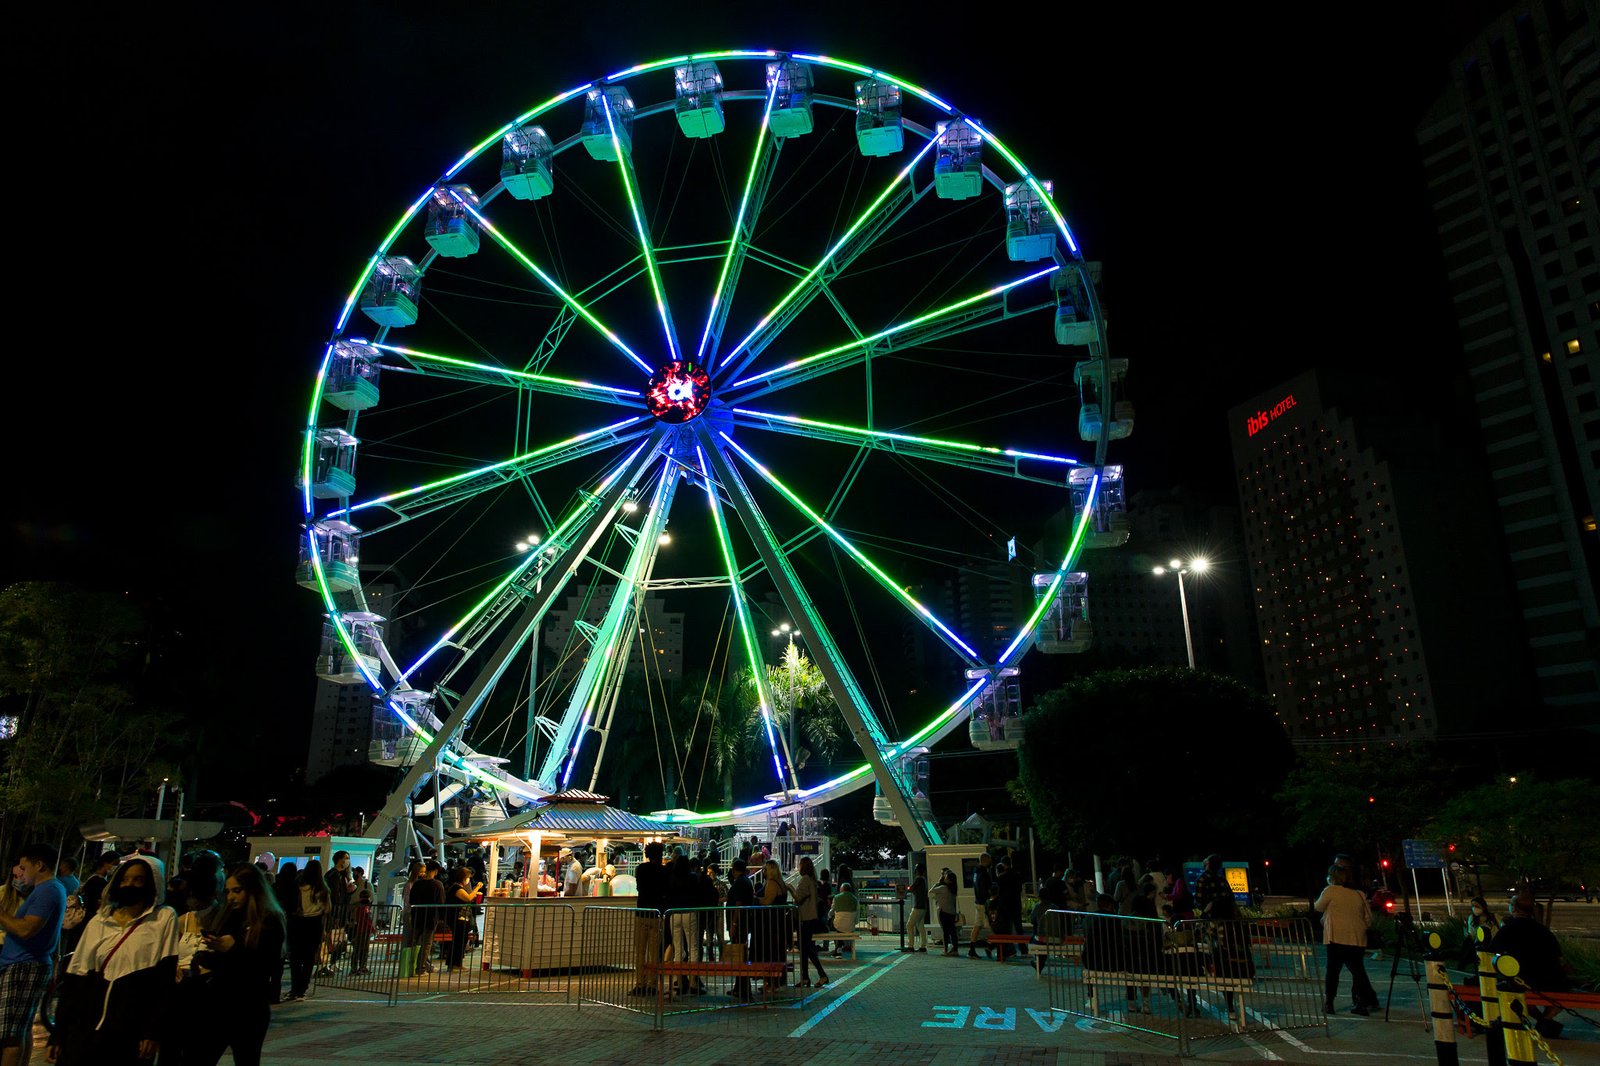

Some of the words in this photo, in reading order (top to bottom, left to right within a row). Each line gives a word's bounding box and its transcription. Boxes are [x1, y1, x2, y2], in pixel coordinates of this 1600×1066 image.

[1247, 410, 1269, 438] ibis
[1269, 393, 1297, 421] HOTEL
[919, 1005, 1131, 1034] PARE
